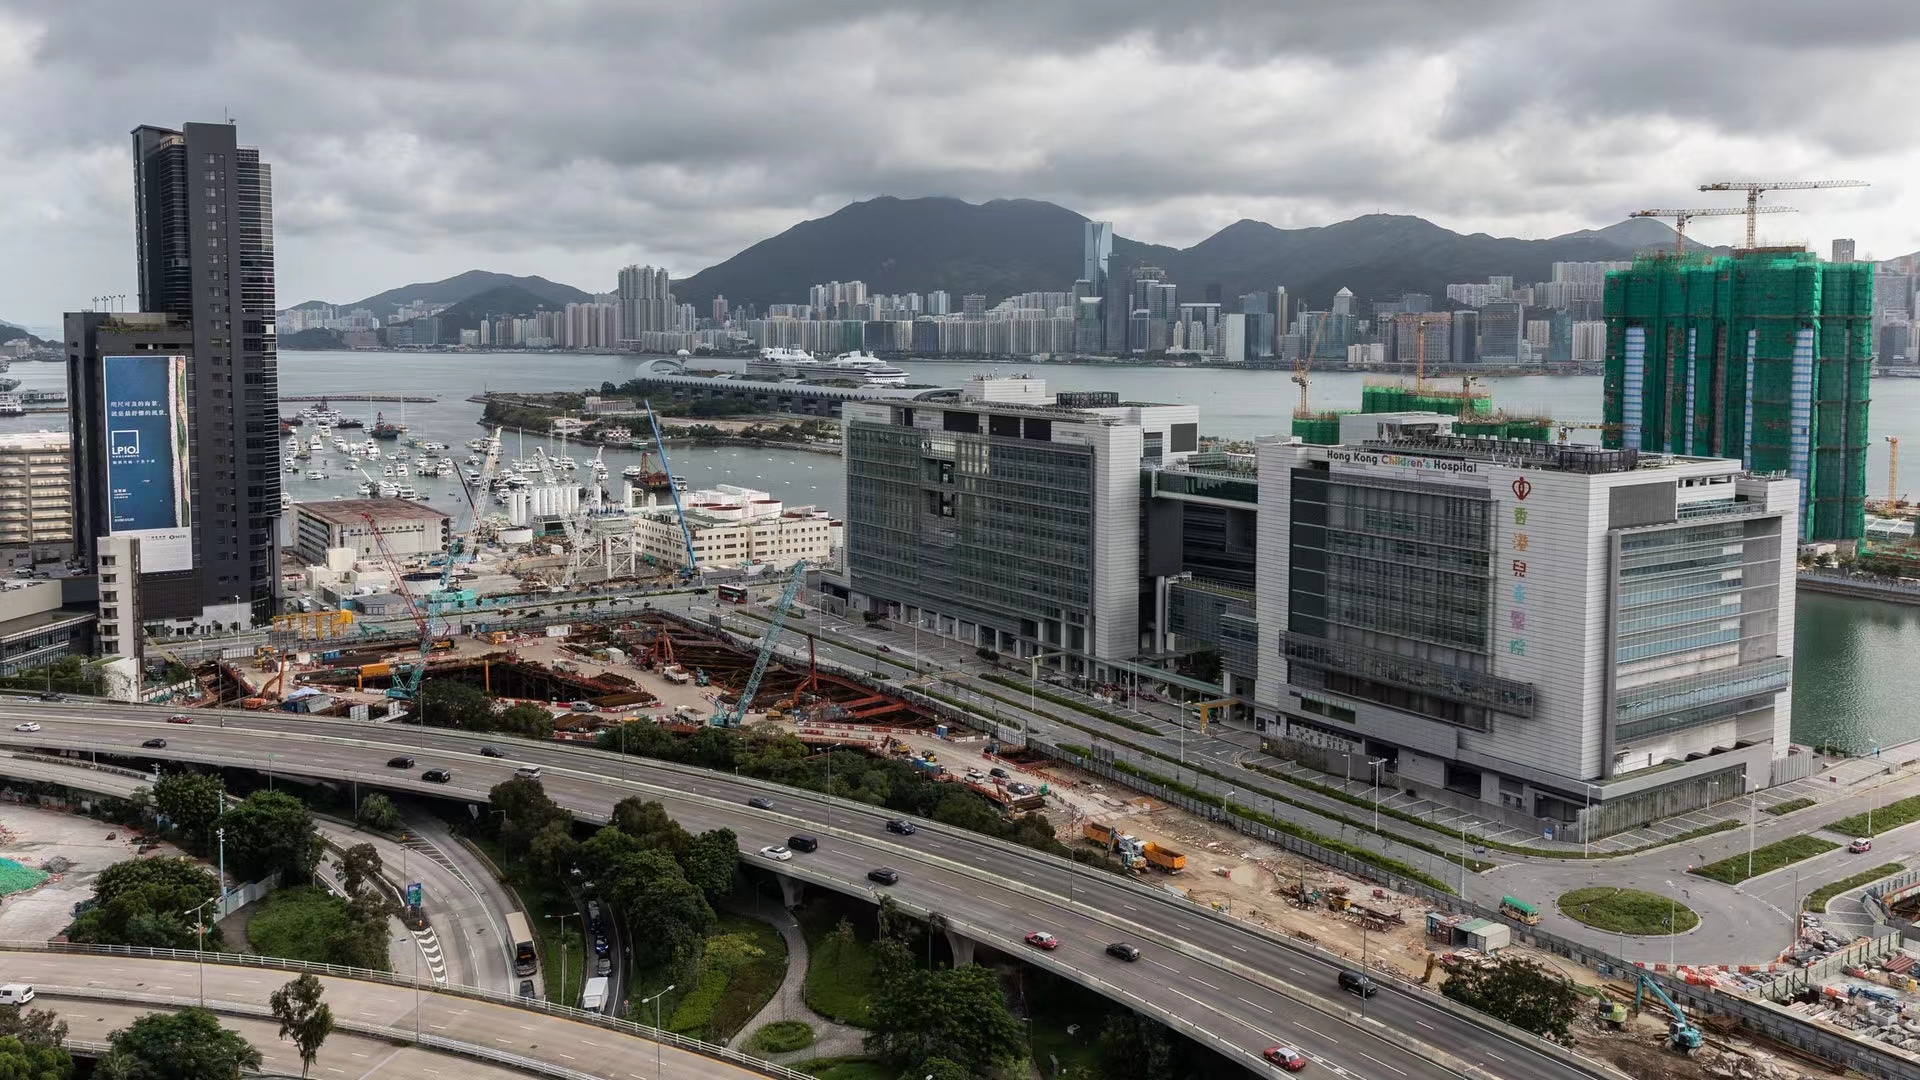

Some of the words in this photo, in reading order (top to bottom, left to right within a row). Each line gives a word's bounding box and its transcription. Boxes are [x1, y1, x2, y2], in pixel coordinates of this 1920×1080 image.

[1327, 449, 1350, 463] Hong
[1353, 452, 1378, 466] Kong
[1381, 454, 1432, 469] Children's
[1433, 460, 1477, 474] Hospital
[1510, 506, 1529, 656] 香港兒童醫院
